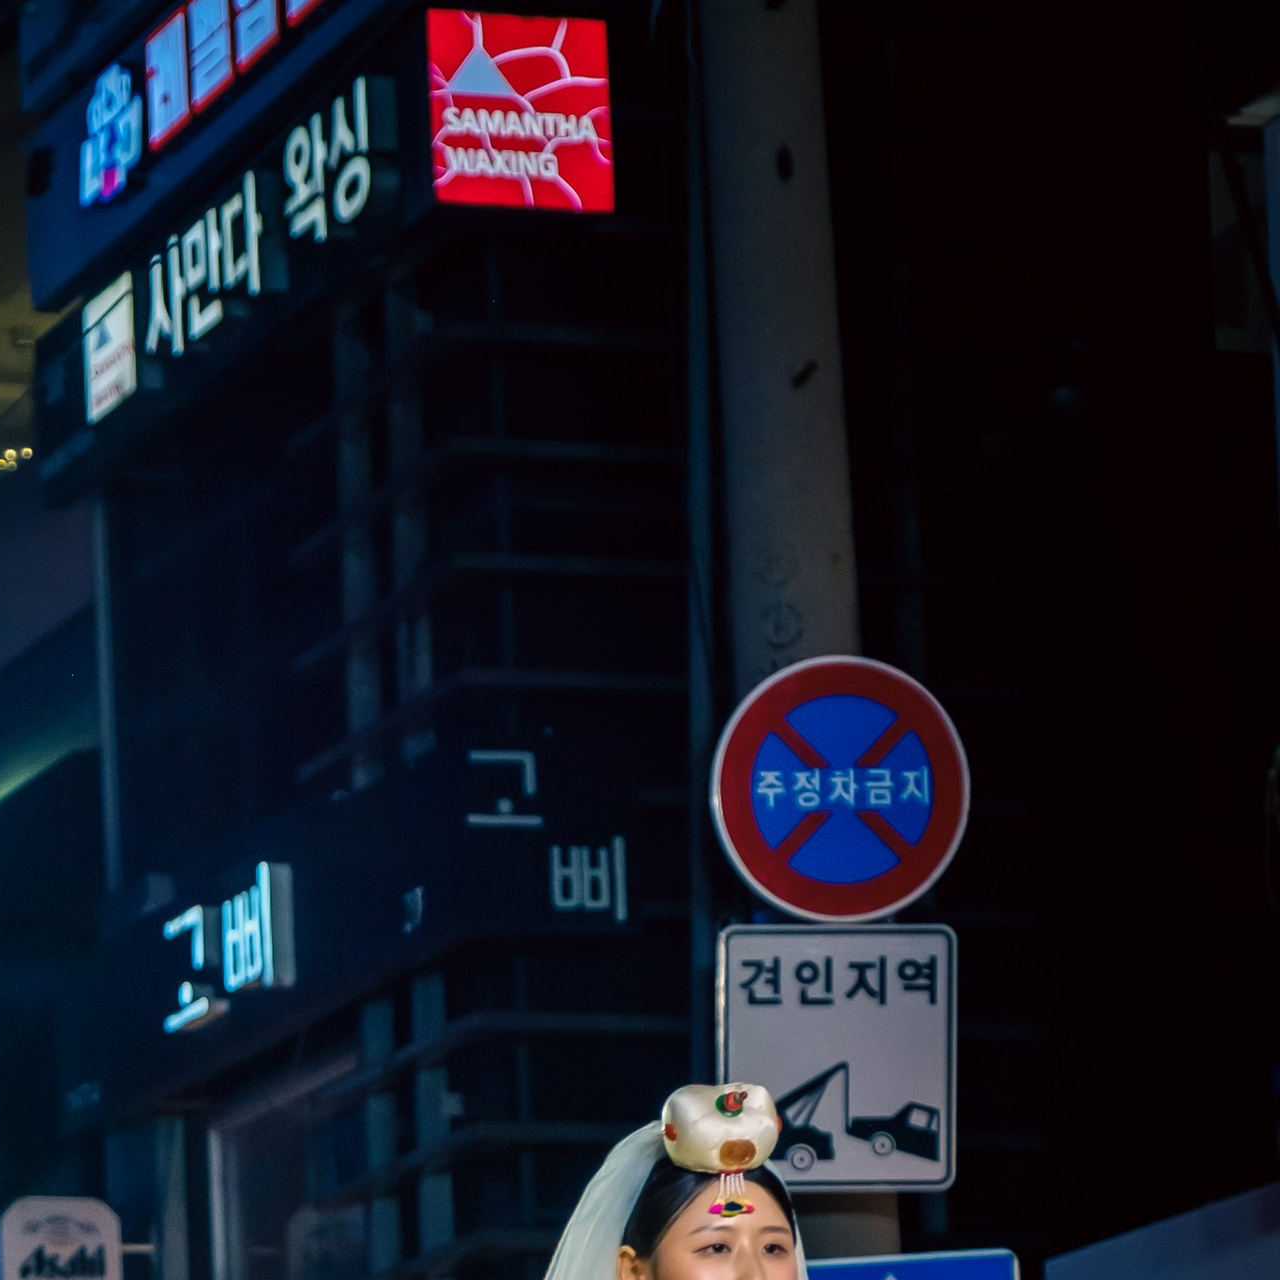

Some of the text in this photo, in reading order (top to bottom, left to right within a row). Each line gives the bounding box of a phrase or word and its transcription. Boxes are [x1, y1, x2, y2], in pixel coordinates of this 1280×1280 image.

[442, 106, 598, 142] SAMANTHA
[445, 146, 558, 179] WAXING
[145, 170, 262, 357] 사만다
[283, 75, 370, 242] 왁싱
[755, 766, 930, 807] 주정차금지
[739, 954, 939, 1005] 견인지역
